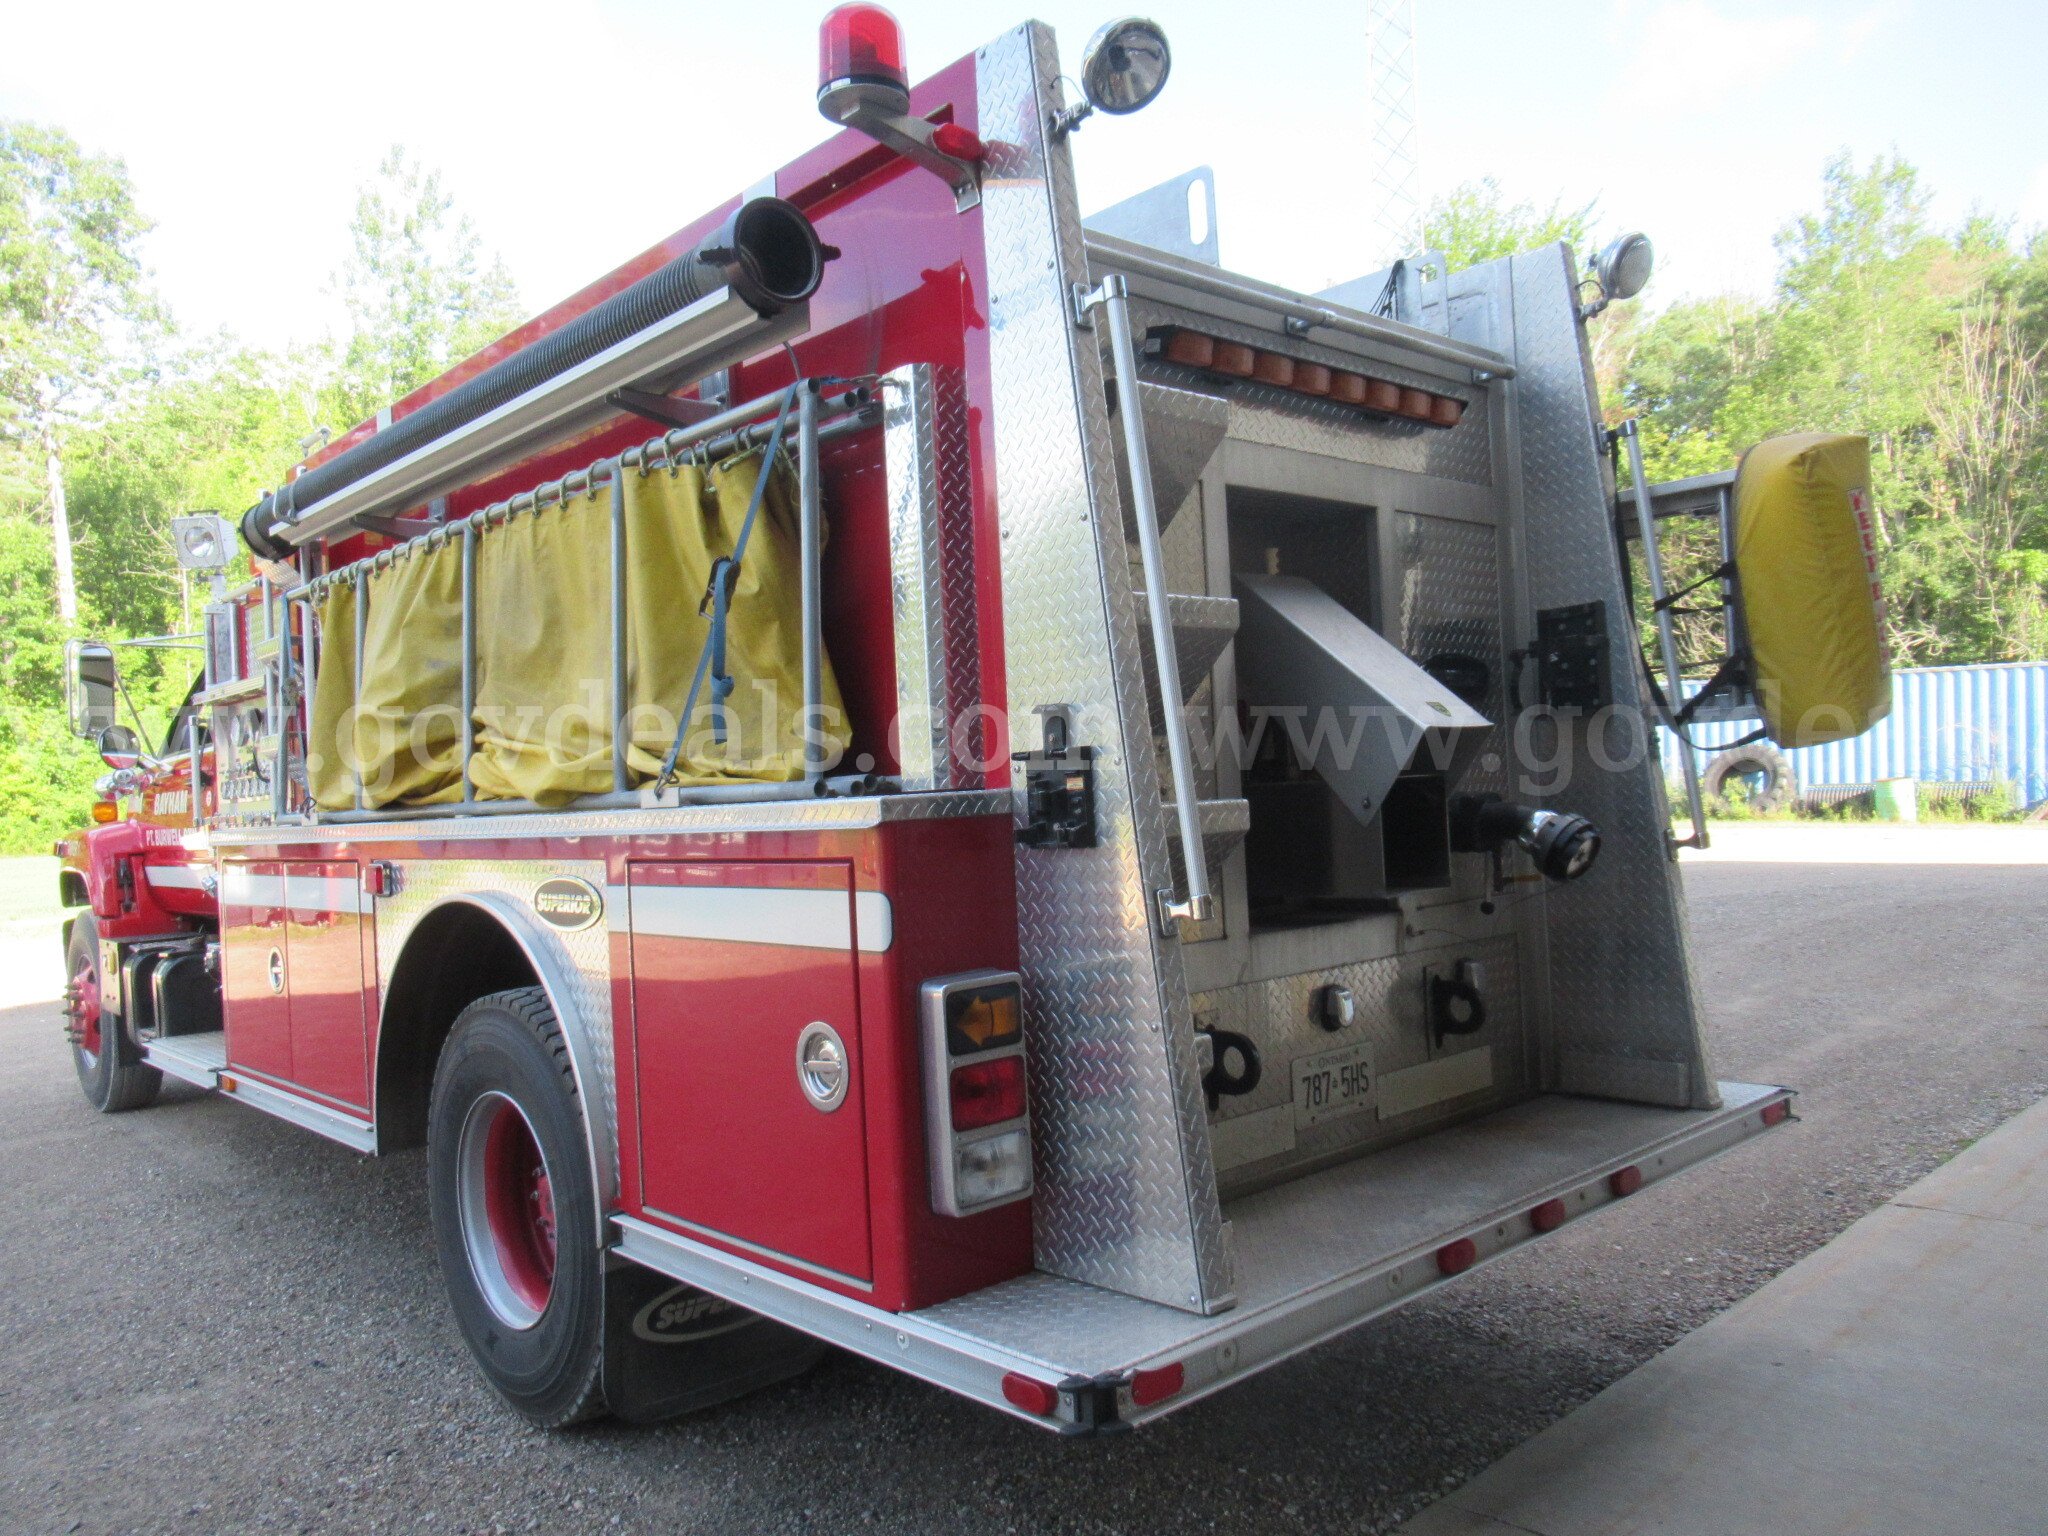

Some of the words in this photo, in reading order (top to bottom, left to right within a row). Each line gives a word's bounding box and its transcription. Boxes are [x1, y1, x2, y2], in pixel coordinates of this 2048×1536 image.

[537, 893, 592, 915] SUPERIOR
[1302, 1071, 1331, 1109] 787
[1340, 1061, 1369, 1098] 5HS
